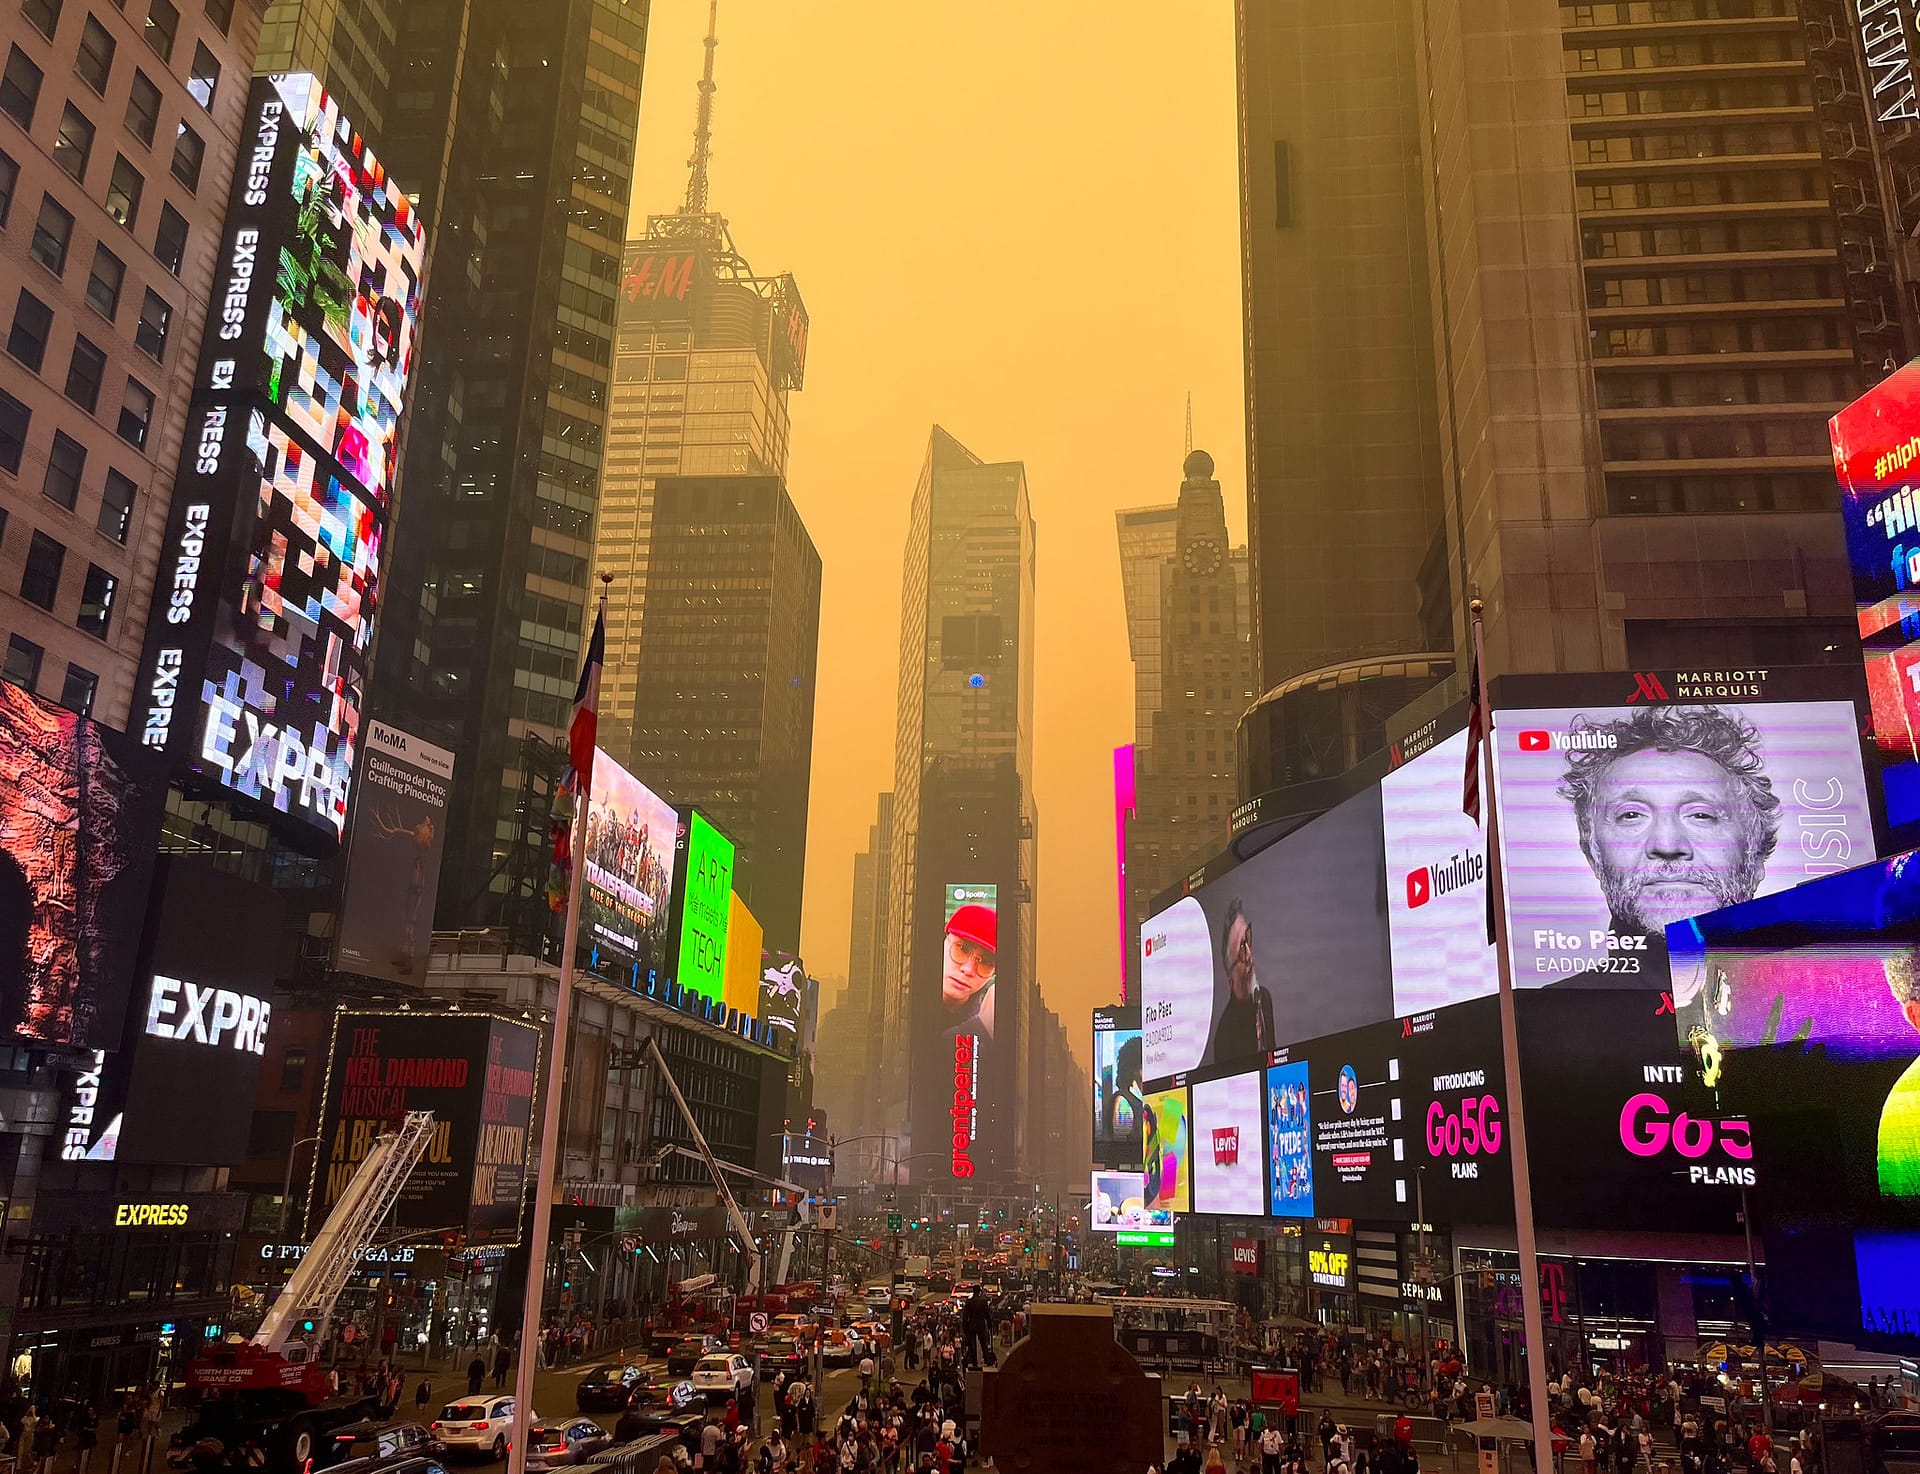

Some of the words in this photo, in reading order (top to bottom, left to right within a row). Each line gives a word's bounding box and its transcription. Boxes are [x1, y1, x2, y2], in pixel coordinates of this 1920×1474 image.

[246, 100, 283, 206] EXPRESS
[219, 229, 260, 341] EXPRESS
[621, 254, 696, 304] H&M
[166, 503, 211, 625] EXPRESS
[1676, 670, 1769, 683] MARRIOTT
[1678, 685, 1761, 697] MARQUIS
[373, 726, 408, 752] MoMA
[1403, 719, 1437, 747] MARRIOTT
[1552, 731, 1617, 750] YouTube
[419, 752, 431, 763] Now
[431, 755, 439, 766] on
[438, 757, 450, 770] view
[1404, 735, 1434, 760] MARQUIS
[368, 769, 404, 795] Crafting
[404, 785, 444, 809] Pinocchio
[369, 757, 412, 783] Guillermo
[412, 776, 426, 789] del
[426, 779, 446, 797] Toro:
[696, 850, 729, 902] ART
[1431, 849, 1483, 897] YouTube
[590, 887, 604, 903] RISE
[605, 896, 613, 908] OF
[615, 901, 626, 916] THE
[965, 890, 988, 899] Spotify
[691, 927, 723, 978] TECH
[1533, 930, 1582, 951] Fito
[1589, 930, 1647, 952] Páez
[1536, 957, 1641, 974] EADDA9223
[353, 1028, 381, 1057] THE
[345, 1058, 382, 1087] NEIL
[386, 1059, 469, 1089] DIAMOND
[1433, 1069, 1485, 1091] INTRODUCING
[340, 1087, 407, 1117] MUSICAL
[950, 1032, 975, 1178] grentperez
[1426, 1094, 1502, 1157] Go5G
[331, 1120, 347, 1161] A
[1279, 1130, 1302, 1158] PRIDE
[1451, 1163, 1478, 1179] PLANS
[1690, 1165, 1756, 1185] PLANS
[115, 1204, 189, 1226] EXPRESS
[1410, 1222, 1433, 1232] SEPORA
[1117, 1234, 1149, 1244] FRIENDS
[1309, 1250, 1328, 1275] 50%
[1328, 1253, 1349, 1276] OFF
